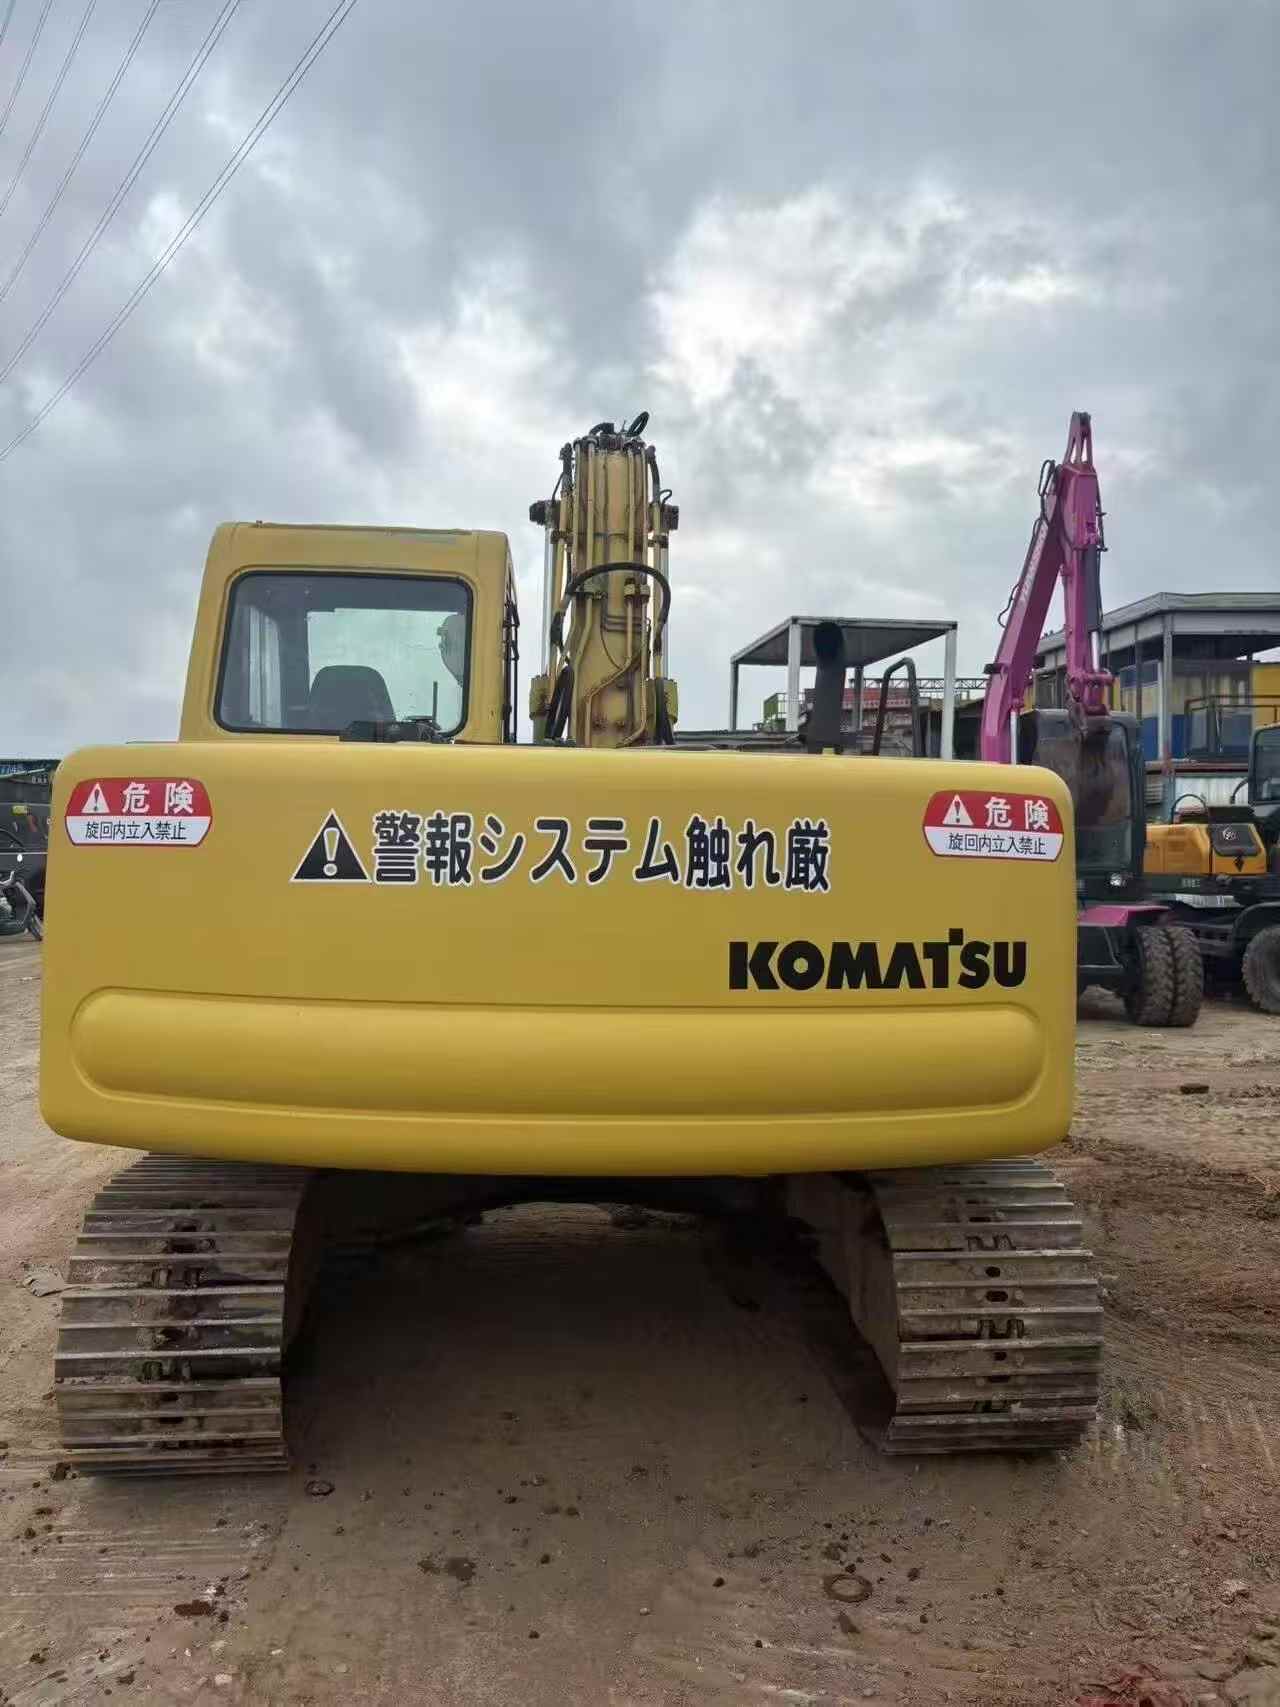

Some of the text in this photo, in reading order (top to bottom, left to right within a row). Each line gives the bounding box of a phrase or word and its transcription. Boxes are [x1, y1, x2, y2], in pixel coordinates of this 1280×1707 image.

[121, 781, 194, 814] 危険
[984, 796, 1050, 830] 危険
[85, 821, 188, 841] 旋回内立入禁止
[947, 832, 1047, 855] 旋回内立入禁止
[373, 811, 831, 890] 警報システム触れ厳
[729, 928, 1027, 990] KOMATSU
